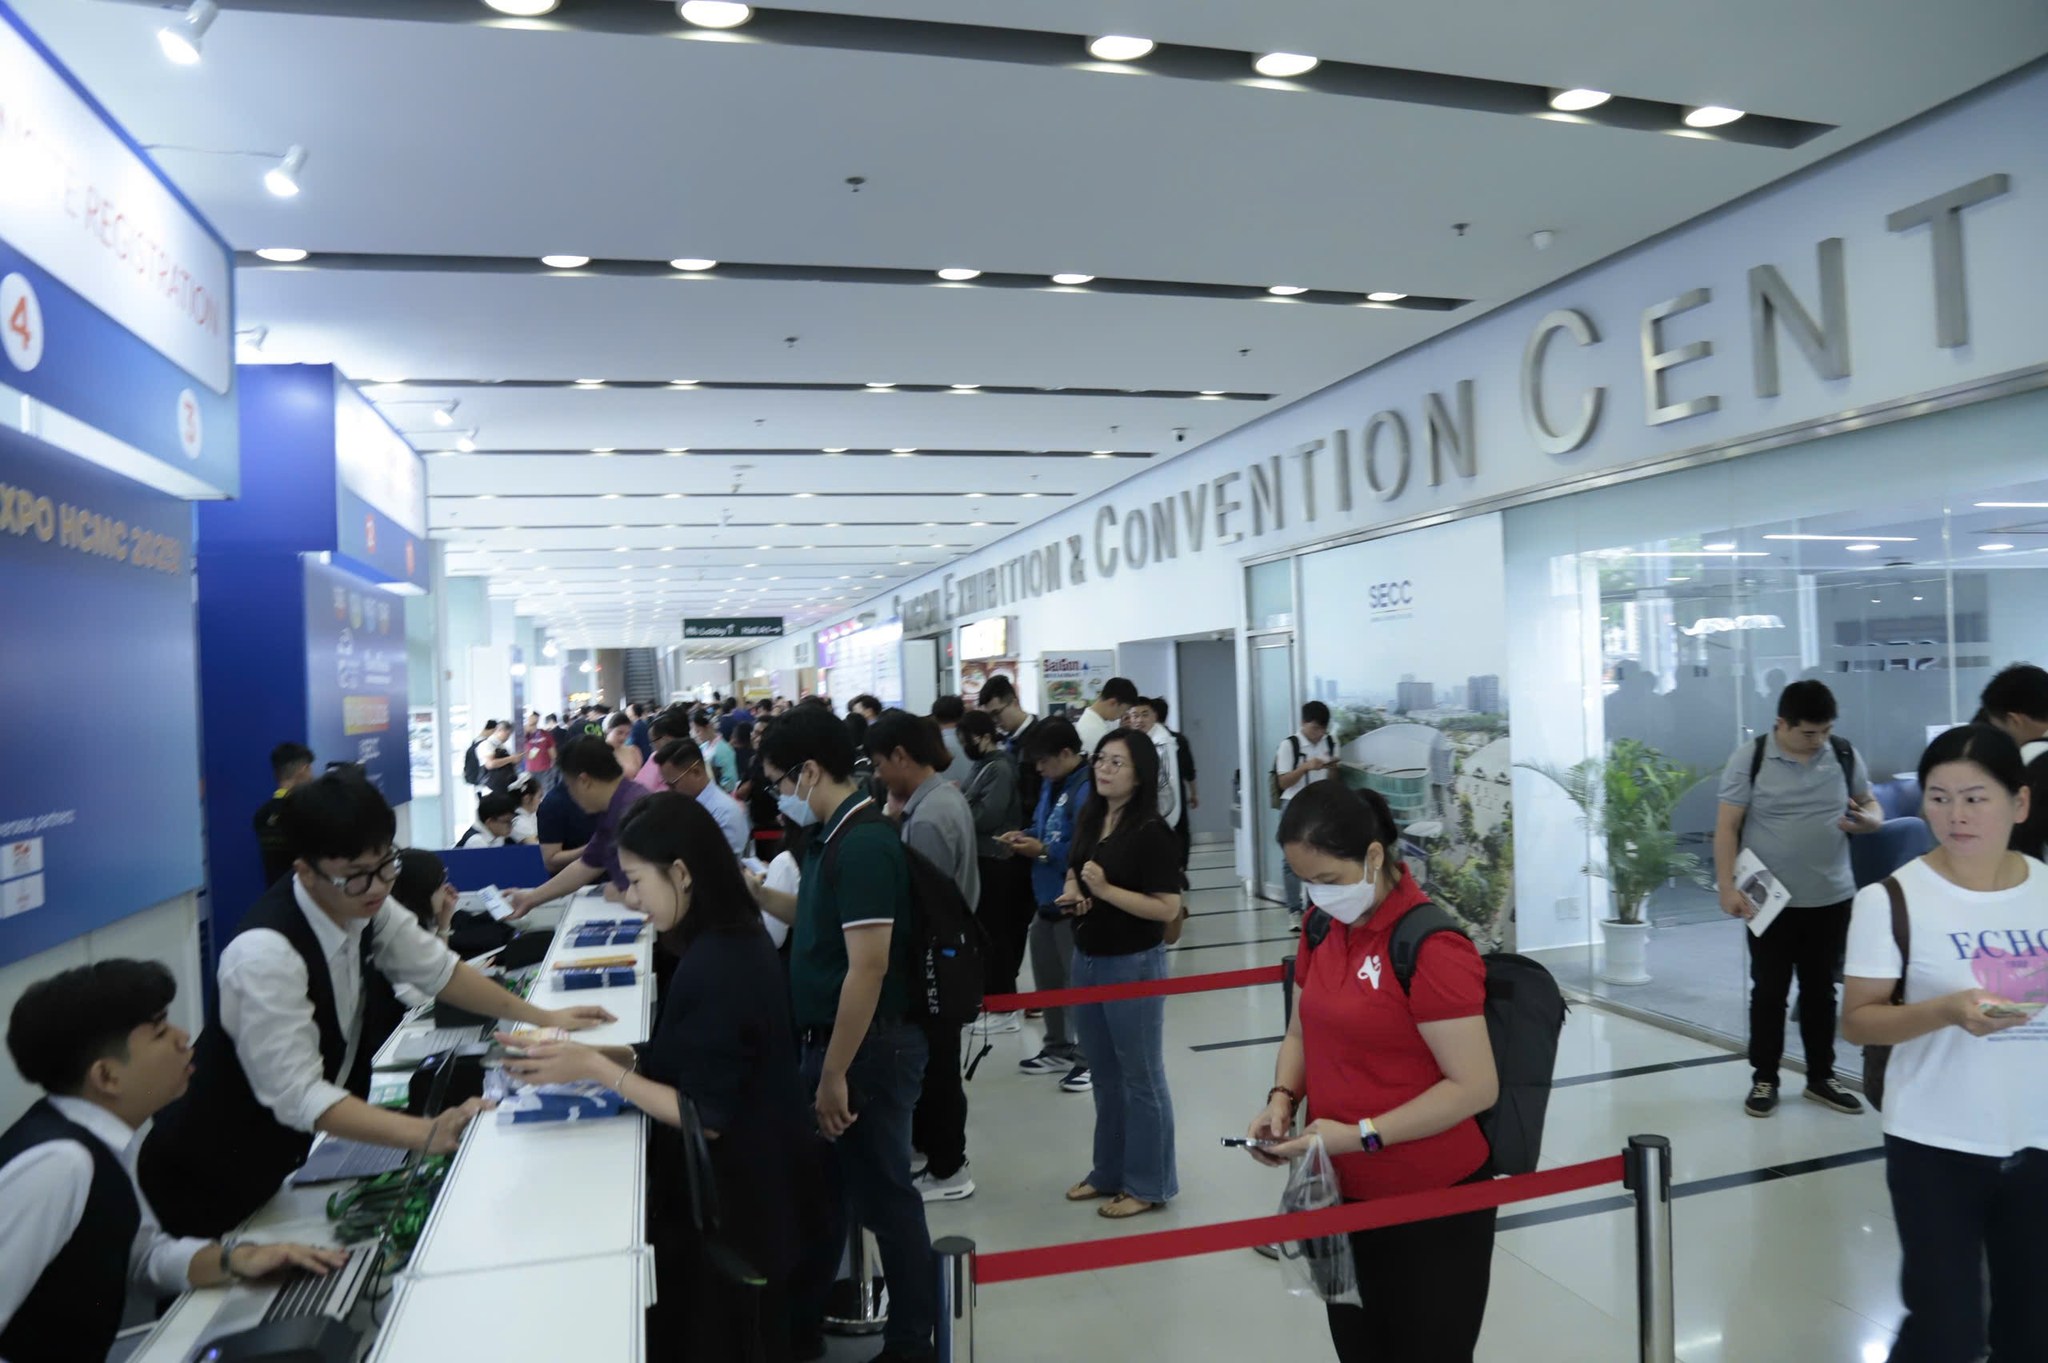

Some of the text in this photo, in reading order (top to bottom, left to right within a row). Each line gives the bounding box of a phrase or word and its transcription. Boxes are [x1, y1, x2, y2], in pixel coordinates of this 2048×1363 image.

[9, 294, 31, 351] 4
[1067, 533, 1087, 585] &
[1094, 379, 1478, 578] CONVENTION
[1521, 172, 2010, 456] CENT
[1368, 579, 1413, 609] SECC
